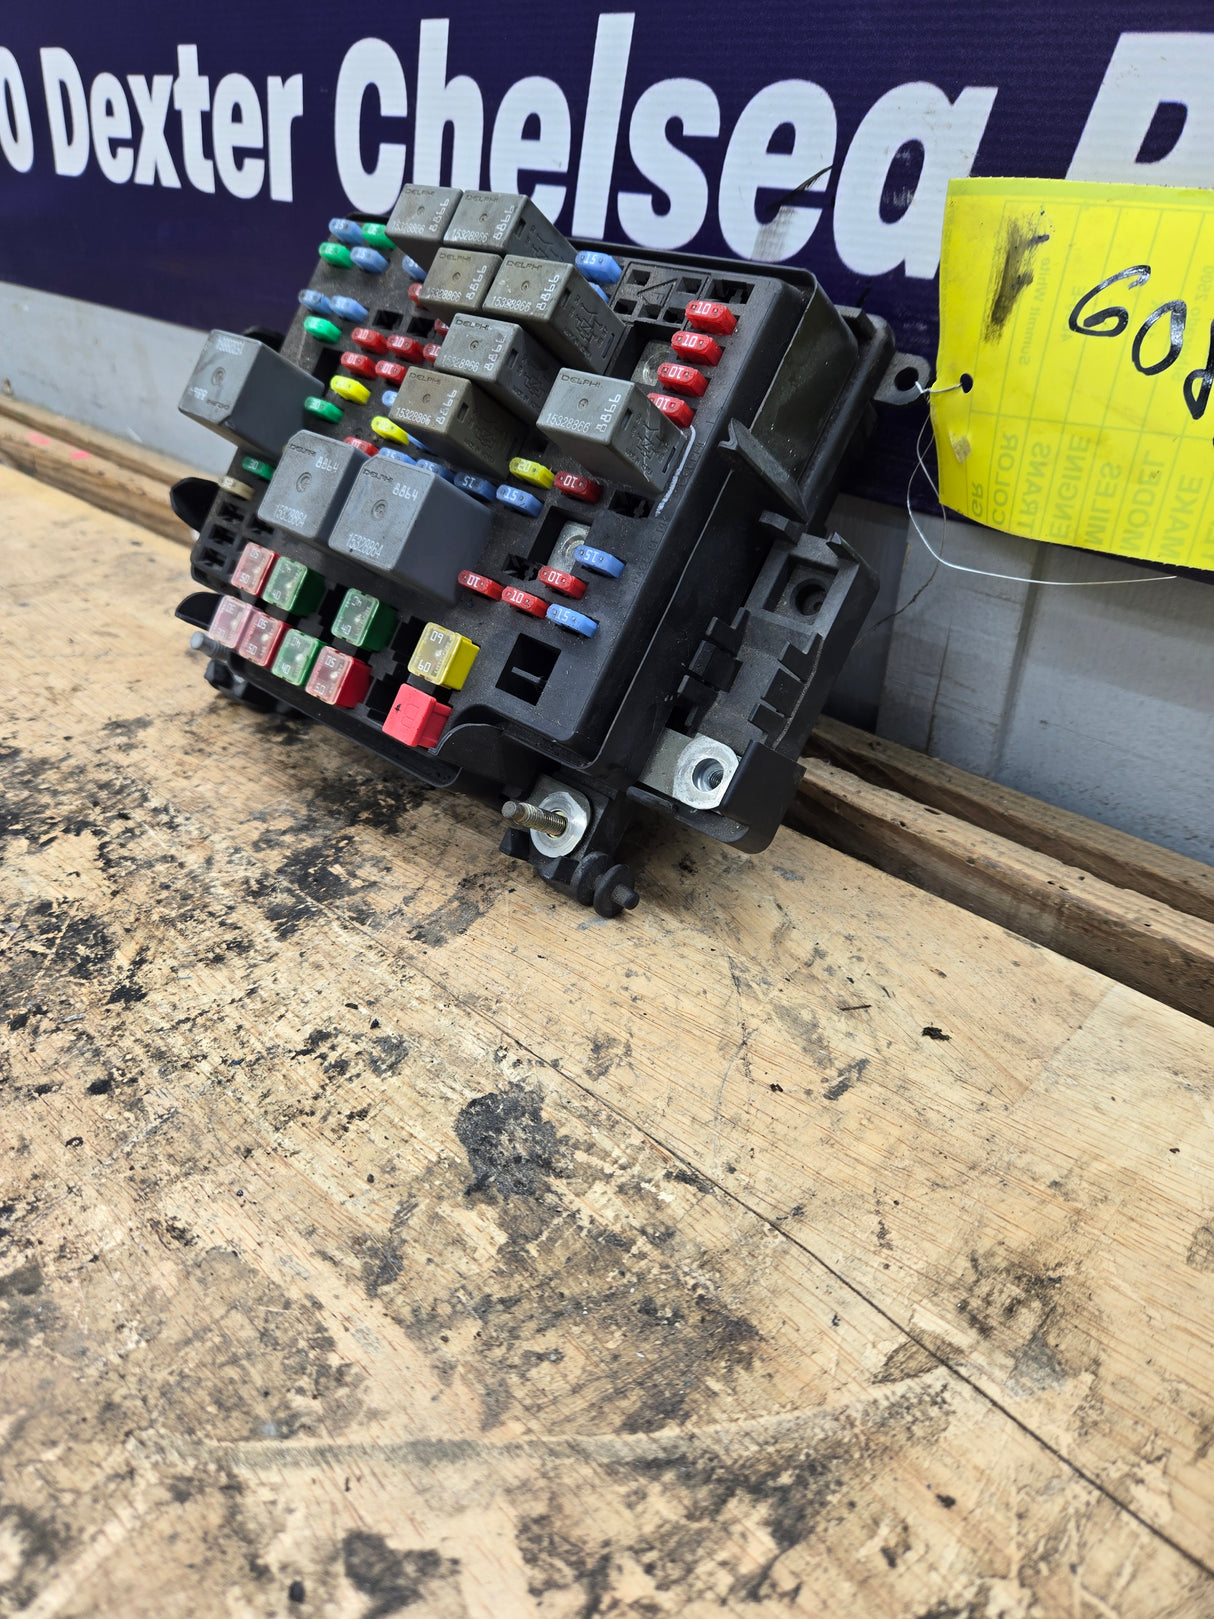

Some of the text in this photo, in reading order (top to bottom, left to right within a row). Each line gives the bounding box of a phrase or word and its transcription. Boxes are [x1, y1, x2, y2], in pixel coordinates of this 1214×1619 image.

[40, 43, 304, 203] Dexter
[334, 12, 998, 280] Chelsea
[583, 252, 597, 265] 15
[536, 274, 560, 311] 8866
[694, 302, 712, 315] 10
[392, 335, 405, 347] 10
[681, 334, 699, 348] 10
[668, 366, 684, 379] 10
[595, 393, 622, 433] 8866
[545, 412, 591, 434] 15328866
[518, 460, 532, 473] 20
[564, 475, 578, 488] 10
[391, 482, 419, 502] 8864
[504, 487, 518, 500] 15
[466, 574, 479, 588] 10
[548, 570, 562, 585] 10
[509, 590, 525, 604] 10
[555, 608, 570, 622] 15
[417, 658, 432, 674] 60
